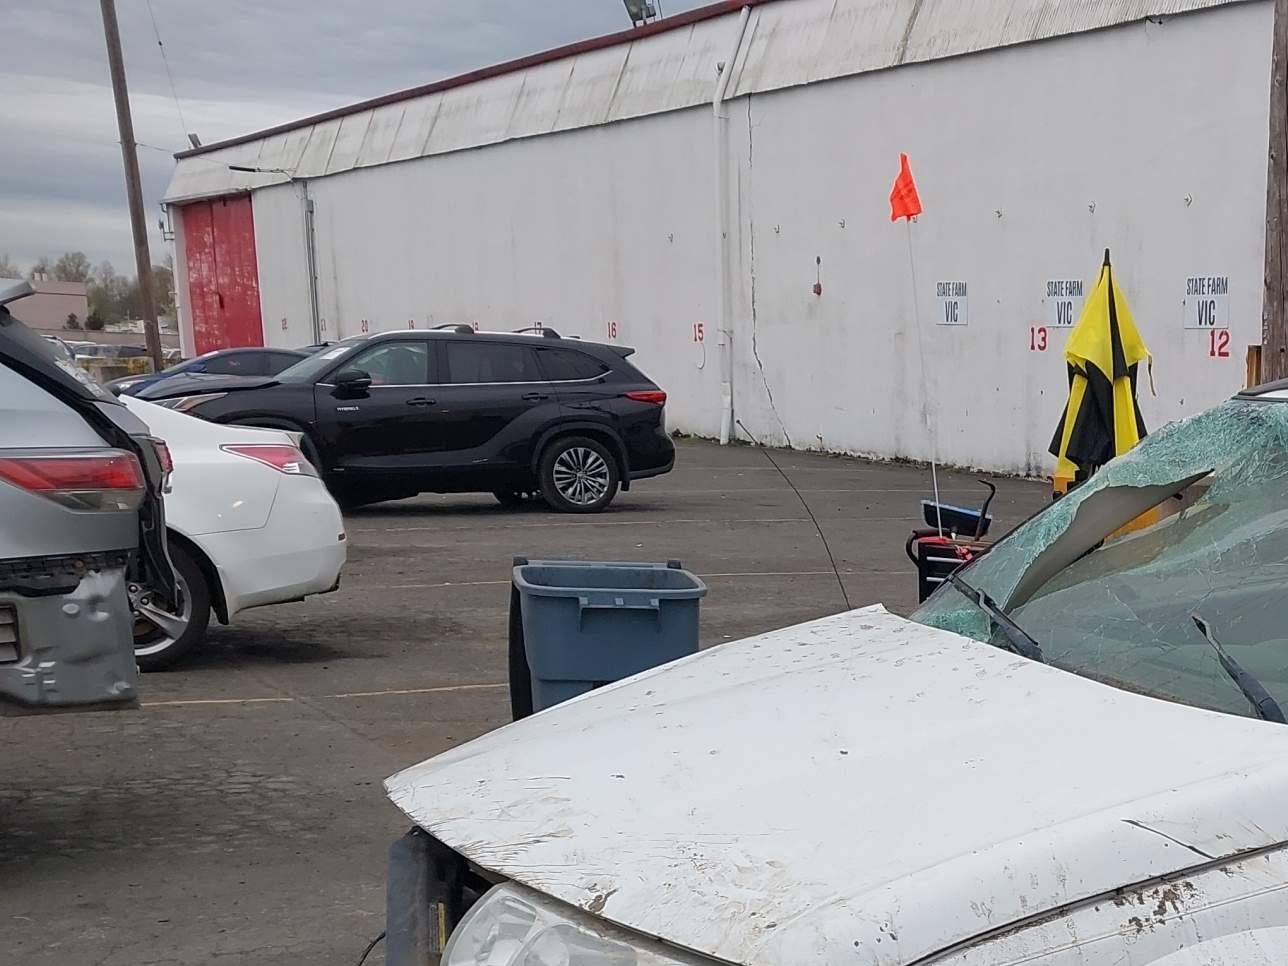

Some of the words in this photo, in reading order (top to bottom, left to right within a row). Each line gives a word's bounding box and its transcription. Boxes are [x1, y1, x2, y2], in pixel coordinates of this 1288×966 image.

[937, 281, 951, 297] STATE
[952, 281, 967, 297] FARM
[1047, 281, 1064, 297] STATE
[1065, 280, 1083, 297] FARM
[1187, 278, 1205, 295] STATE
[1207, 276, 1228, 295] FARM
[944, 300, 959, 323] VIC
[1057, 301, 1073, 325] VIC
[1198, 300, 1216, 326] VIC
[607, 322, 617, 339] 16
[694, 323, 704, 342] 15
[1030, 326, 1048, 351] 13
[1209, 329, 1230, 357] 12
